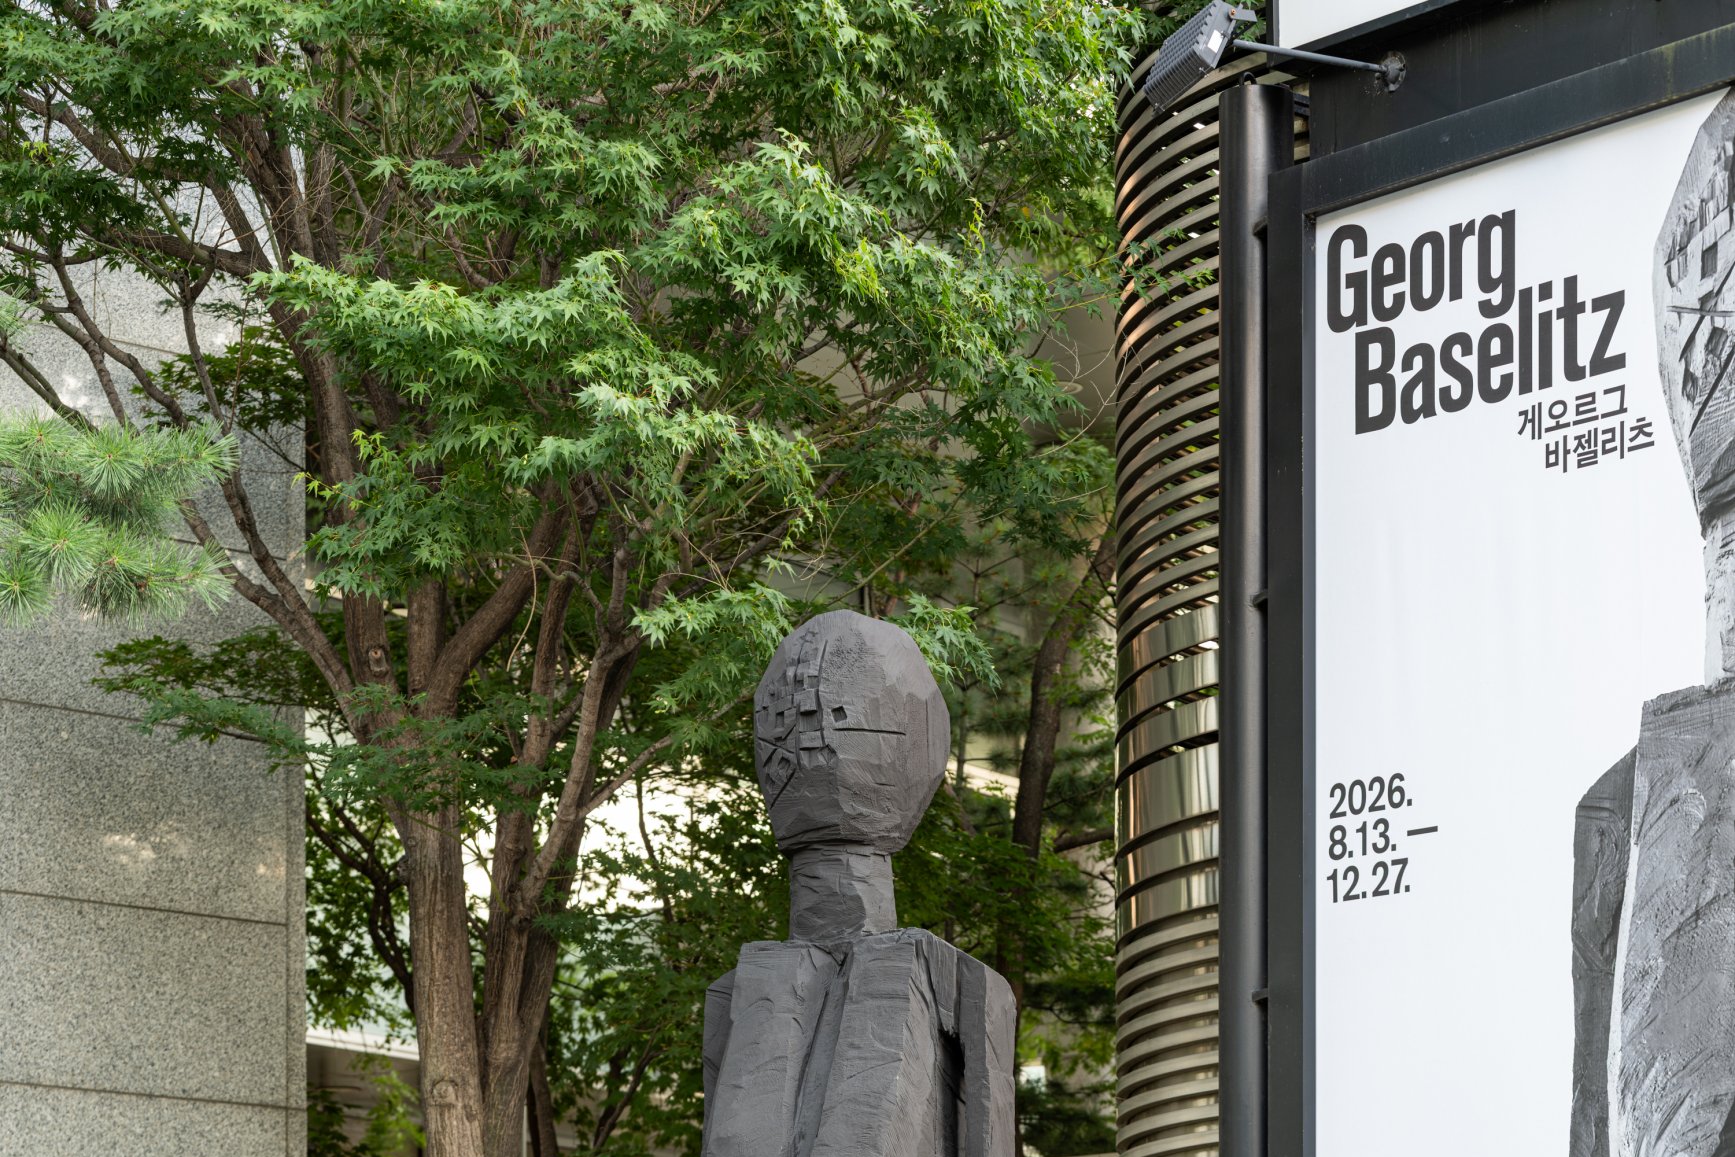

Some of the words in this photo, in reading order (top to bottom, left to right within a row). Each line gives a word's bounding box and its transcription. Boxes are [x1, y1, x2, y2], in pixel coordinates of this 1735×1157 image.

[1327, 209, 1516, 333] Georg
[1355, 274, 1627, 435] Baselitz
[1518, 384, 1628, 441] 게오르그
[1545, 416, 1655, 474] 바젤리츠
[1329, 772, 1413, 819] 2026.
[1326, 857, 1411, 903] 12.27.
